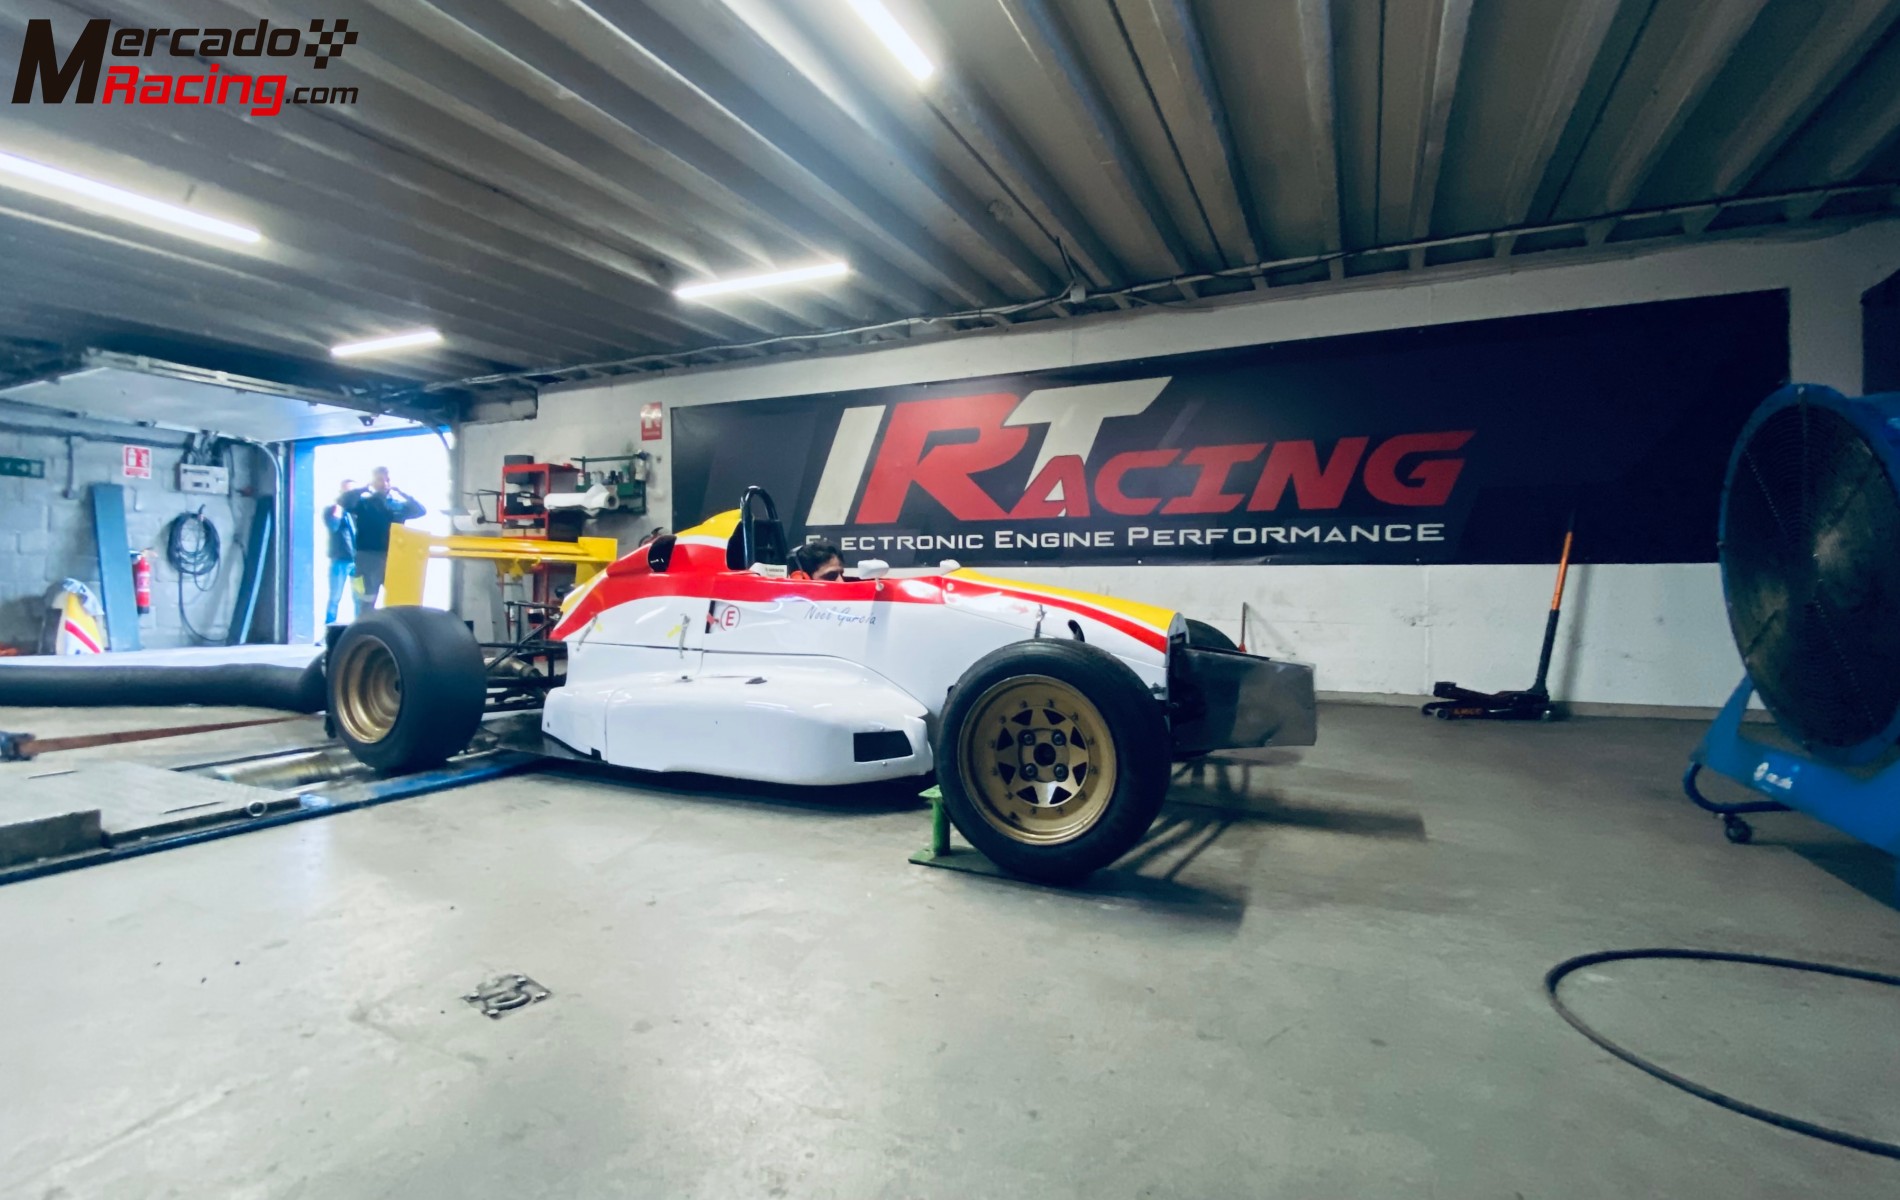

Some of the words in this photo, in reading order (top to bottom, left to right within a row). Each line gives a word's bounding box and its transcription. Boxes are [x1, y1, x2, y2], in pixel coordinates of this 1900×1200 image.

[805, 376, 1173, 526] IRT
[806, 534, 984, 551] EECTRONIC
[995, 530, 1115, 549] ENGINE
[1128, 523, 1446, 547] PERFORMANCE
[725, 610, 736, 627] E
